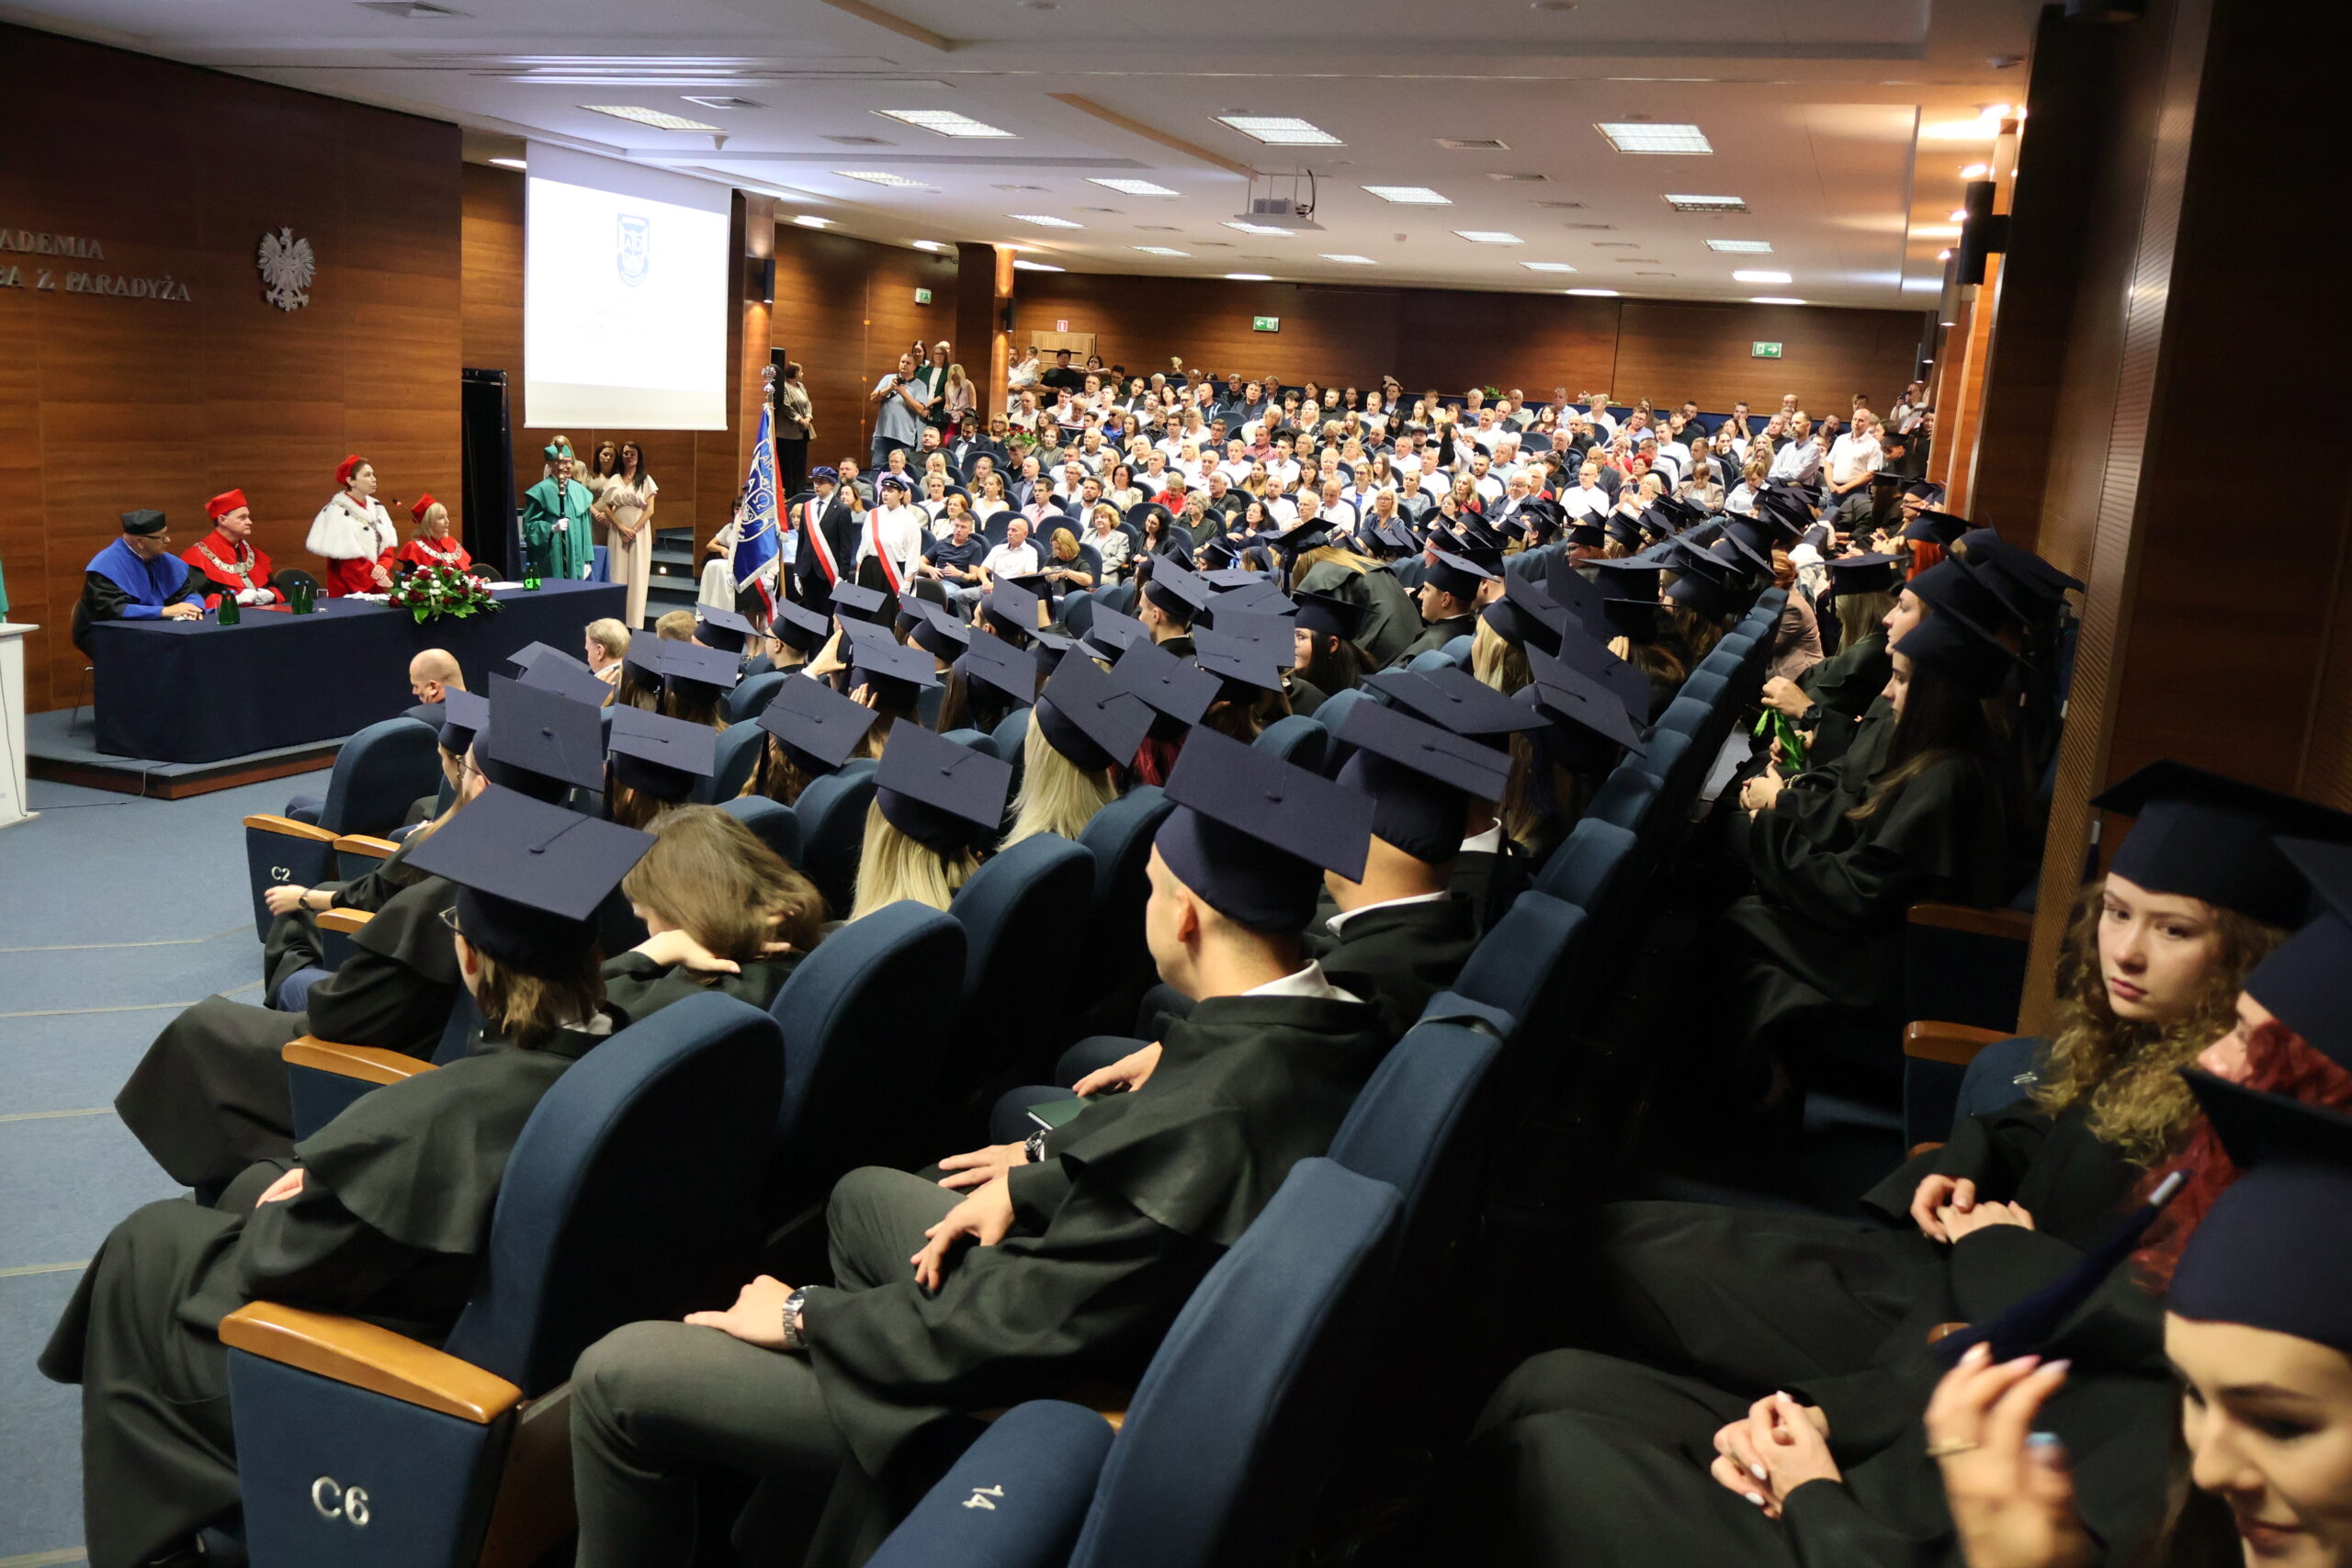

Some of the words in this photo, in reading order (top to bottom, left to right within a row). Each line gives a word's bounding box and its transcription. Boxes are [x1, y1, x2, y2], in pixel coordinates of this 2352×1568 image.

[37, 268, 55, 289] Z
[65, 271, 191, 301] PARADYŻA
[271, 866, 290, 882] C2
[311, 1475, 369, 1526] C6
[962, 1484, 1004, 1509] 14
